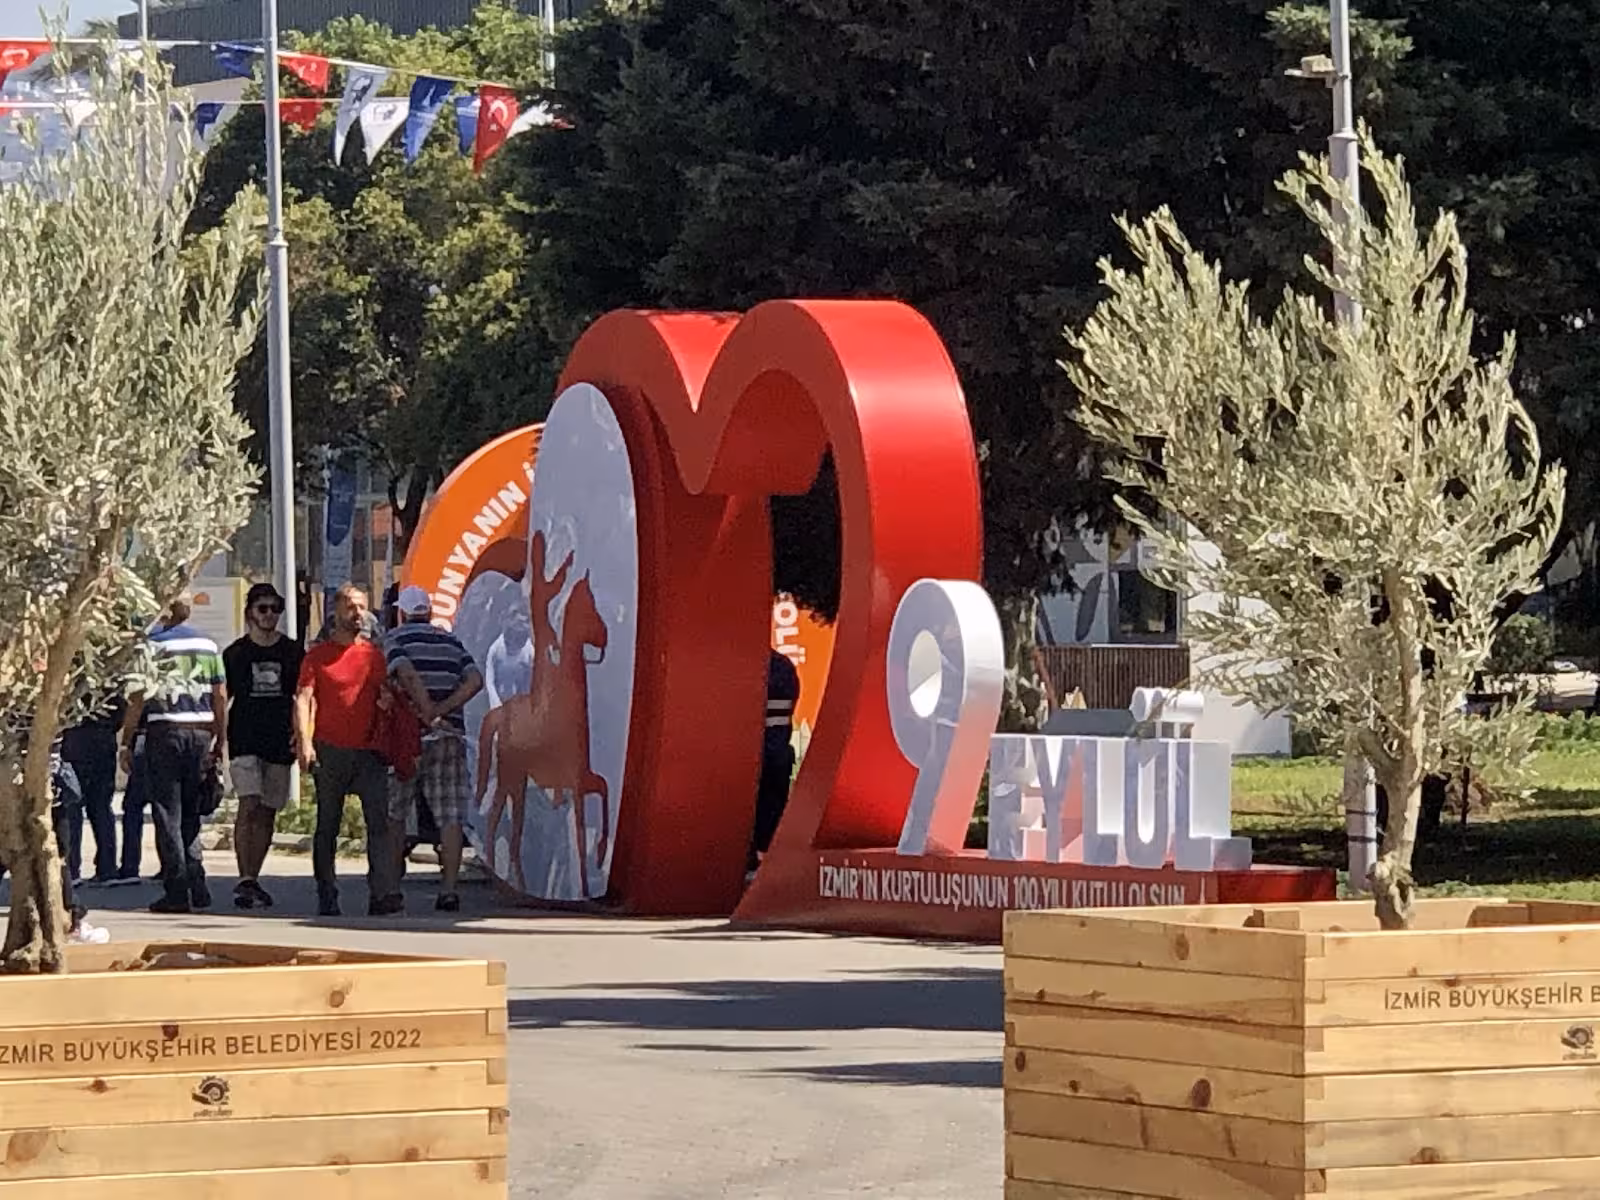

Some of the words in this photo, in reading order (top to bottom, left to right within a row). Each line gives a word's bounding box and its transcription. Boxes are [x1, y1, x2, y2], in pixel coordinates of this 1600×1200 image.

[886, 578, 994, 857] 9
[986, 686, 1236, 872] EYLÜL
[819, 856, 878, 901] İZMİR'İN
[881, 868, 1009, 913] KURTULUŞUNUN
[1384, 986, 1442, 1010] İZMİR
[1449, 981, 1584, 1009] BÜYÜKŞEHİR
[63, 1033, 217, 1063] BÜYÜKŞEHİR
[225, 1026, 361, 1056] BELEDİYESİ
[369, 1028, 422, 1050] 2022
